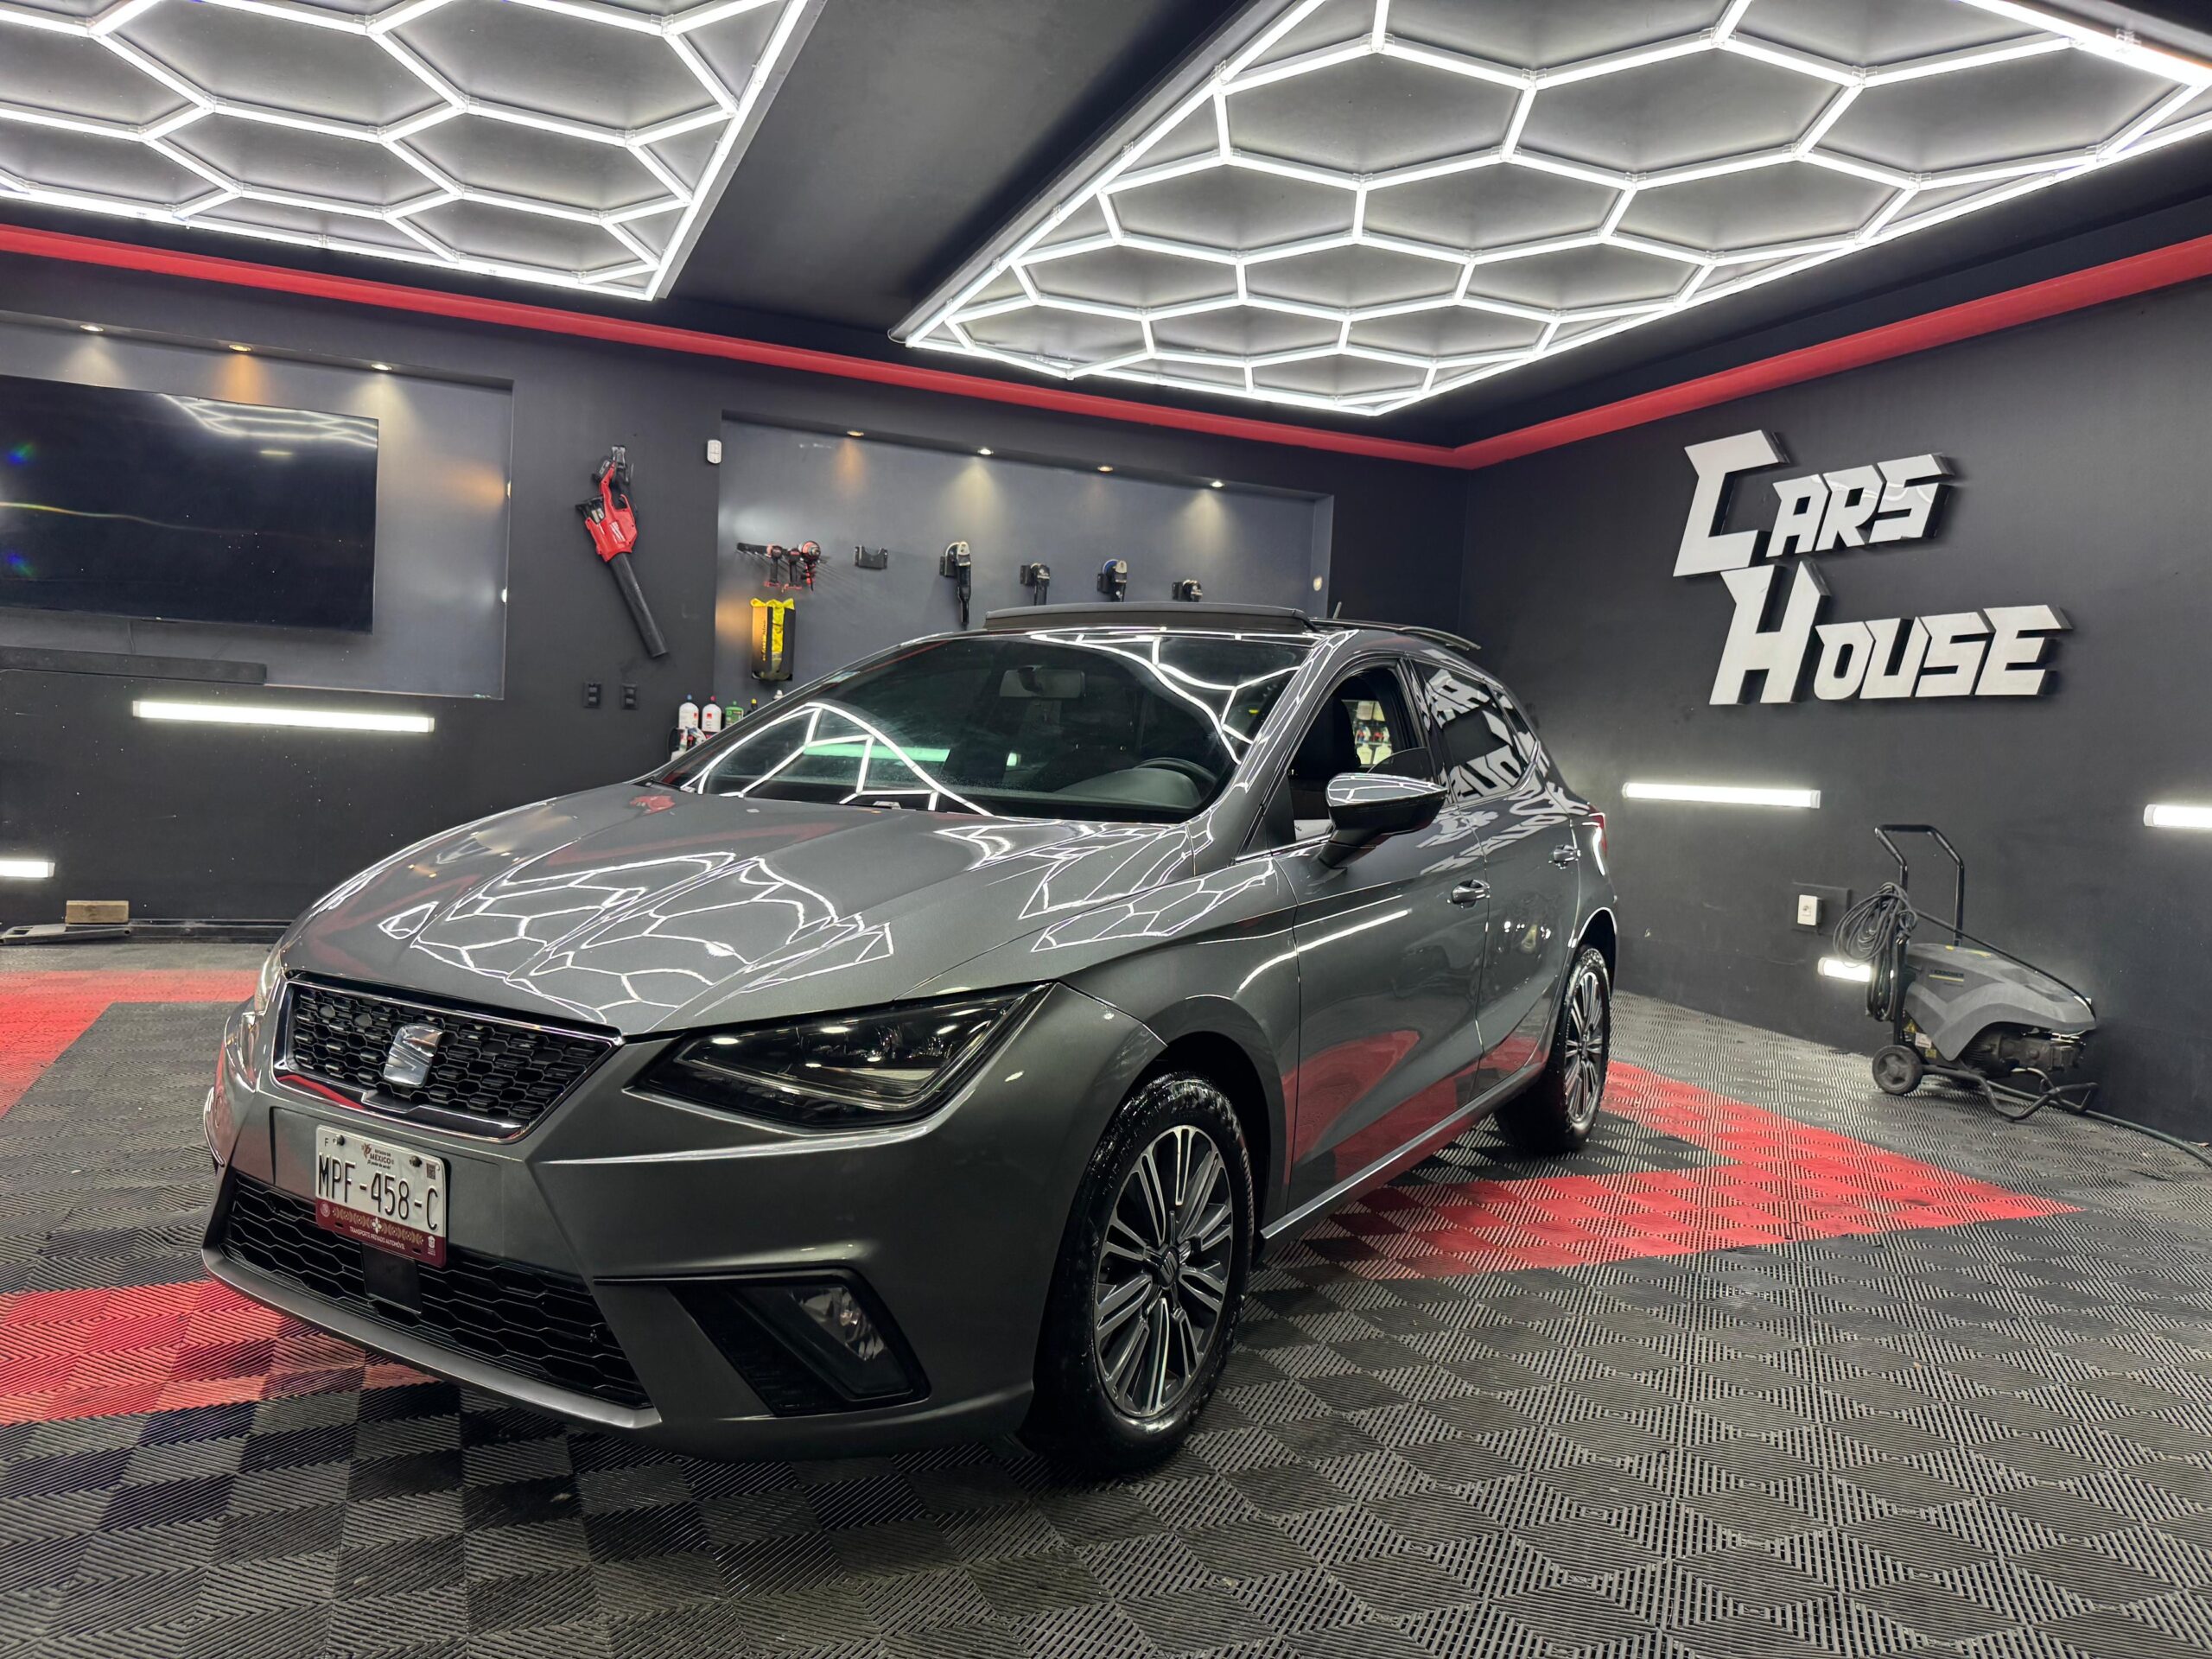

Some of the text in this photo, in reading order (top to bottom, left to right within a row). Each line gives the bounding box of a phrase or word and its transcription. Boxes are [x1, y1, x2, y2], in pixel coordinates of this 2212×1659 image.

[1673, 429, 1952, 577] CARS
[1709, 561, 2070, 706] HOUSE
[318, 1153, 439, 1231] MPF-458-C
